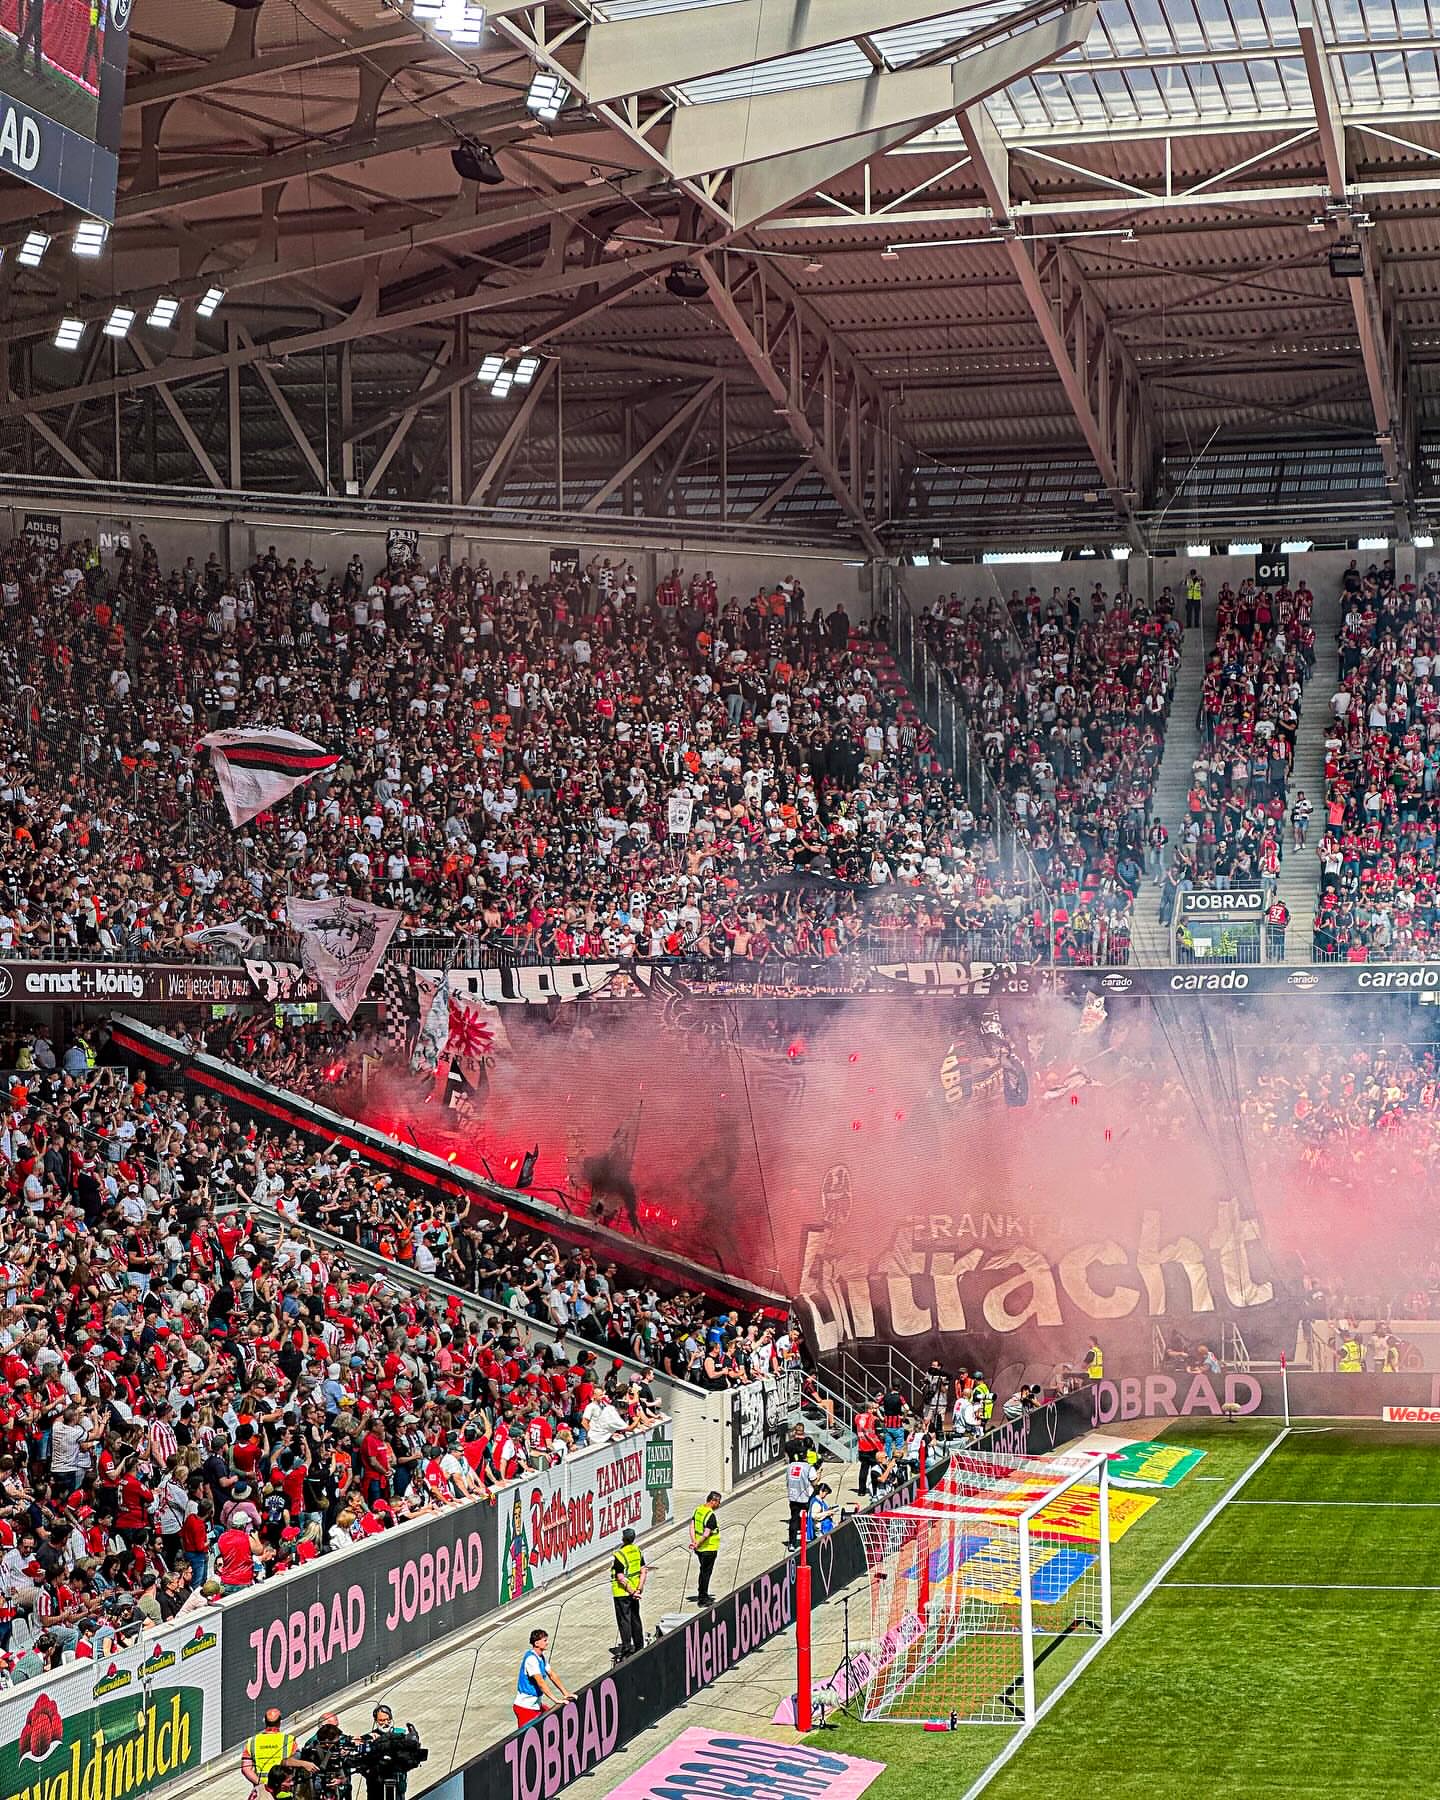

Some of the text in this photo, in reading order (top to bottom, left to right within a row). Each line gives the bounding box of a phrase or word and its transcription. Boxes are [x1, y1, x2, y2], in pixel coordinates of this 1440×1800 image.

[25, 521, 60, 534] ADLER
[1185, 894, 1261, 909] JOBRAD
[1101, 977, 1133, 986] carado
[1170, 970, 1249, 989] carado
[1287, 975, 1319, 984] carado
[1358, 968, 1439, 987] carado
[1090, 1373, 1263, 1428] JOBRAD
[597, 1450, 642, 1498] TANNEN
[647, 1445, 673, 1462] TANNEN
[530, 1487, 594, 1569] Rothaus
[599, 1491, 642, 1539] ZÄPFLE
[386, 1532, 483, 1631] JOBRAD
[246, 1585, 366, 1700] JOBRAD
[685, 1608, 728, 1697] Mein
[504, 1677, 619, 1800] JOBRAD
